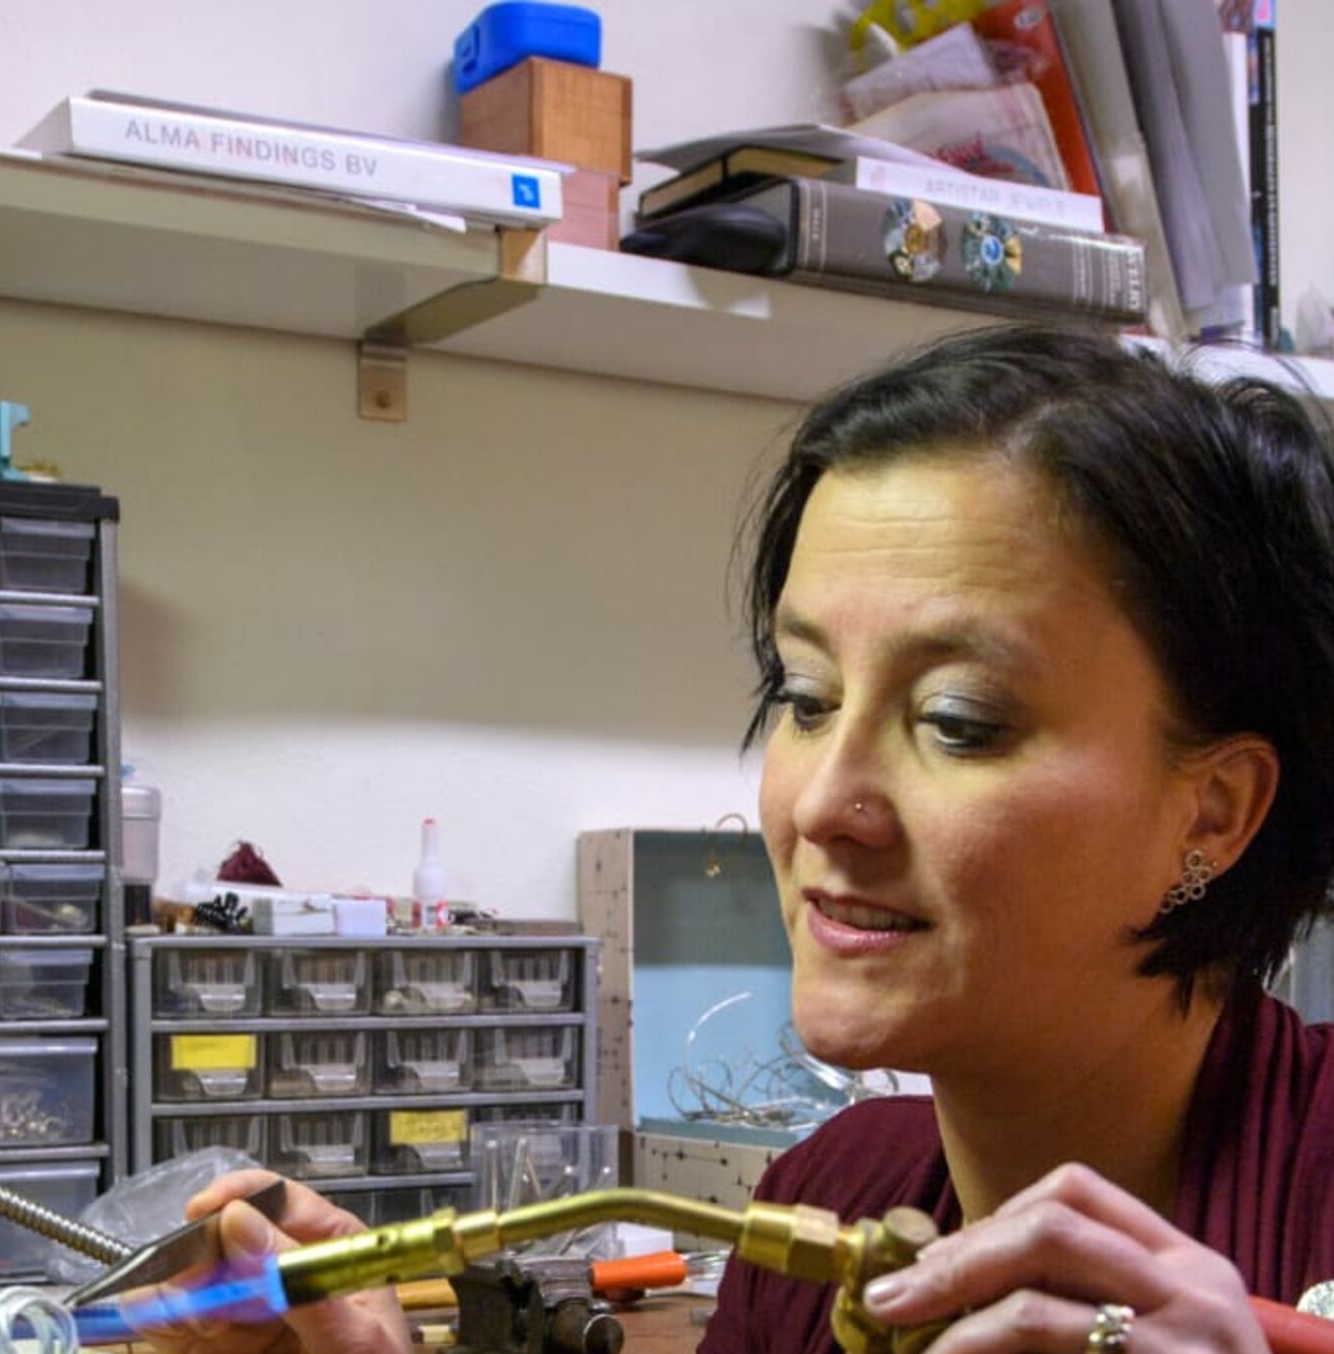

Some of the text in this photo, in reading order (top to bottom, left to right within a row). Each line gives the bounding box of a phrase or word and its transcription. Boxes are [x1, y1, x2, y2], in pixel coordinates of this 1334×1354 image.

[125, 119, 379, 177] ALMA FINDINGS BV
